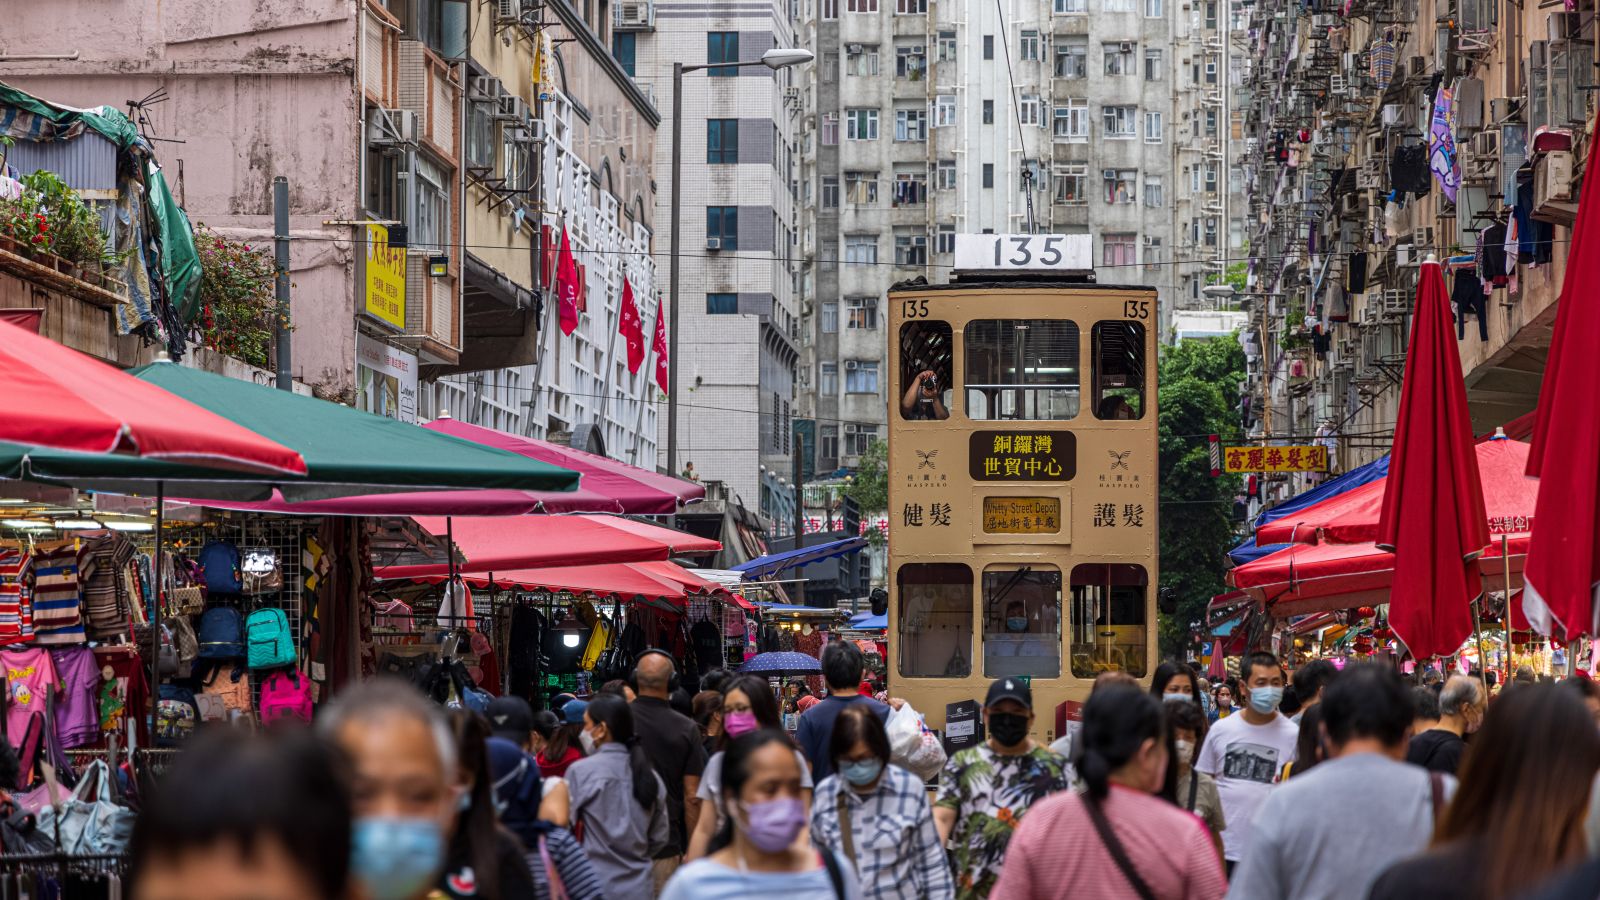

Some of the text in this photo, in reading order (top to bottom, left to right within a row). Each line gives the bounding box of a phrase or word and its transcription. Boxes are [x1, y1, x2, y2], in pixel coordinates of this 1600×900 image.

[994, 237, 1064, 266] 135
[902, 299, 930, 318] 135
[1123, 300, 1150, 320] 135
[993, 434, 1053, 454] 銅鑼灣
[983, 457, 1063, 477] 世貿中心
[1227, 447, 1325, 470] 富麗華髮型
[903, 502, 952, 527] 健髮
[985, 502, 1057, 516] Whitty Street Depot
[1093, 503, 1144, 527] 護髮
[1202, 643, 1210, 655] P
